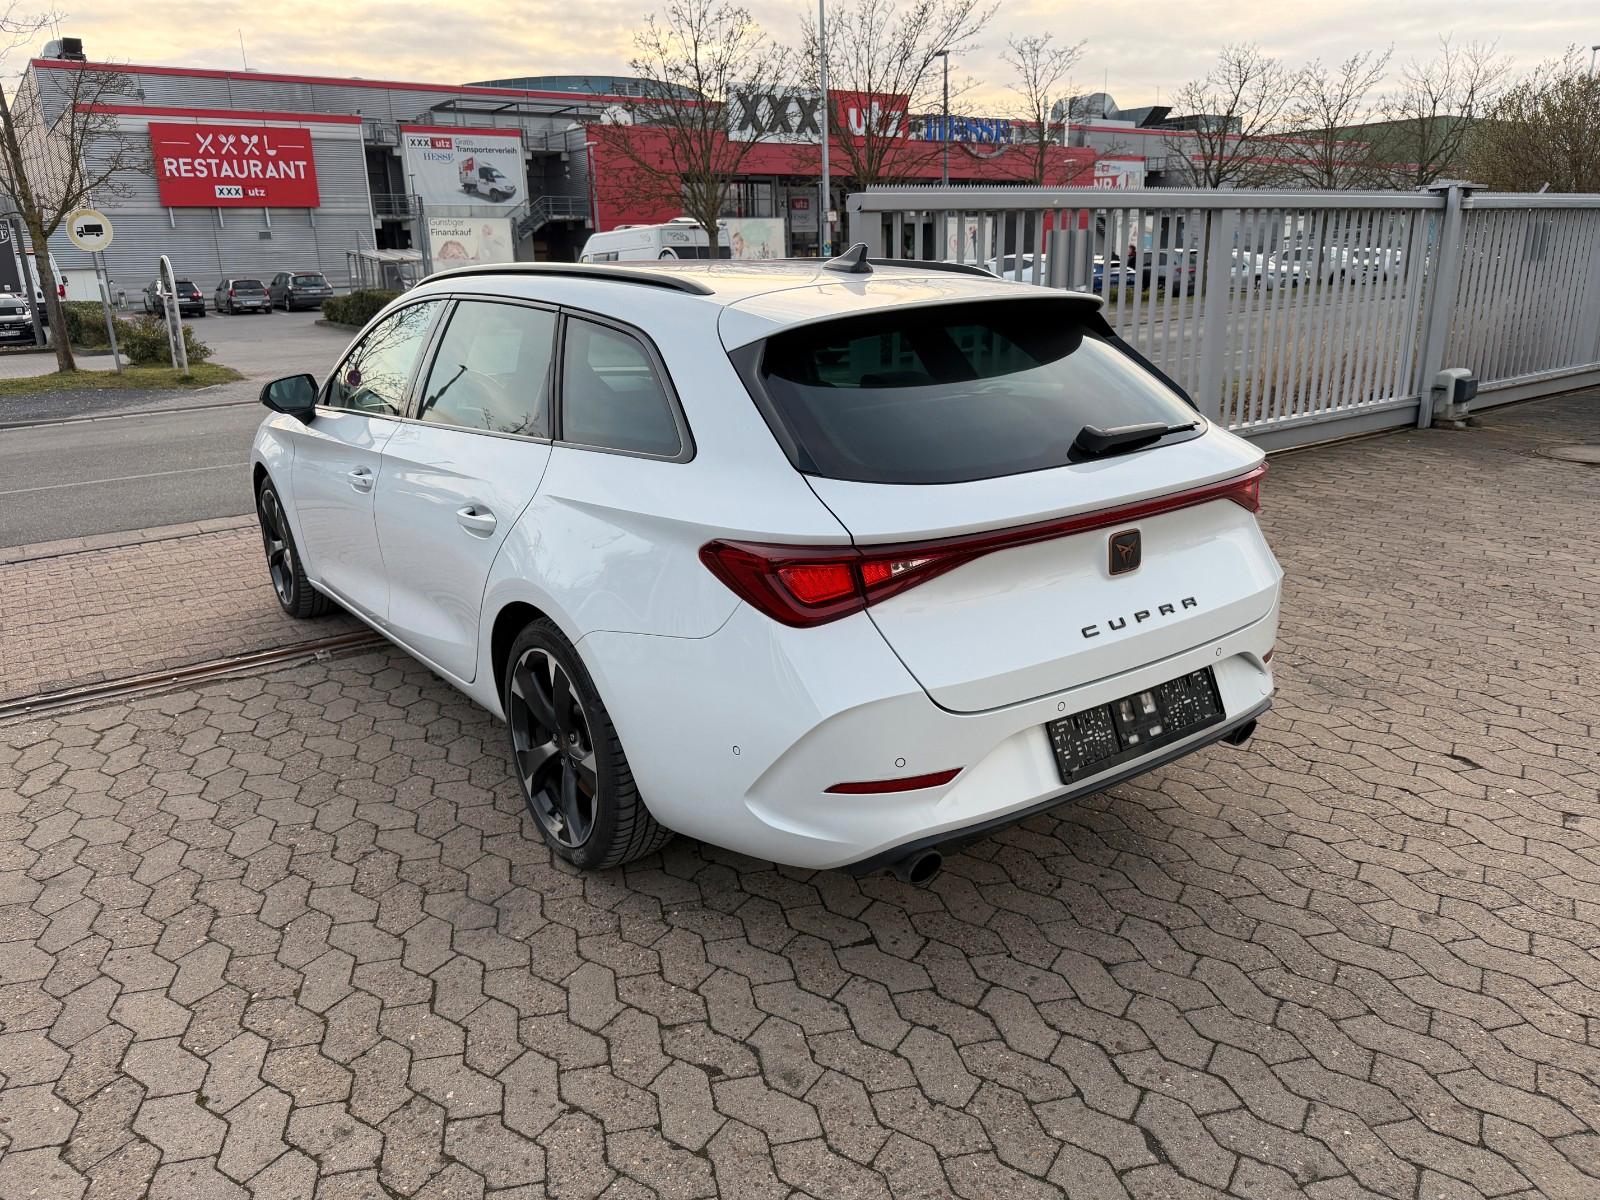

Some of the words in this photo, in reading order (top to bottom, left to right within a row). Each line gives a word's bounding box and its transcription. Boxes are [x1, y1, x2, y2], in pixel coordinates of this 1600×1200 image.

[456, 146, 517, 154] Transporterverleih
[423, 152, 454, 161] HESSE
[163, 158, 307, 179] RESTAURANT
[431, 228, 471, 236] Finanzkauf
[1081, 597, 1197, 638] CUPRA
